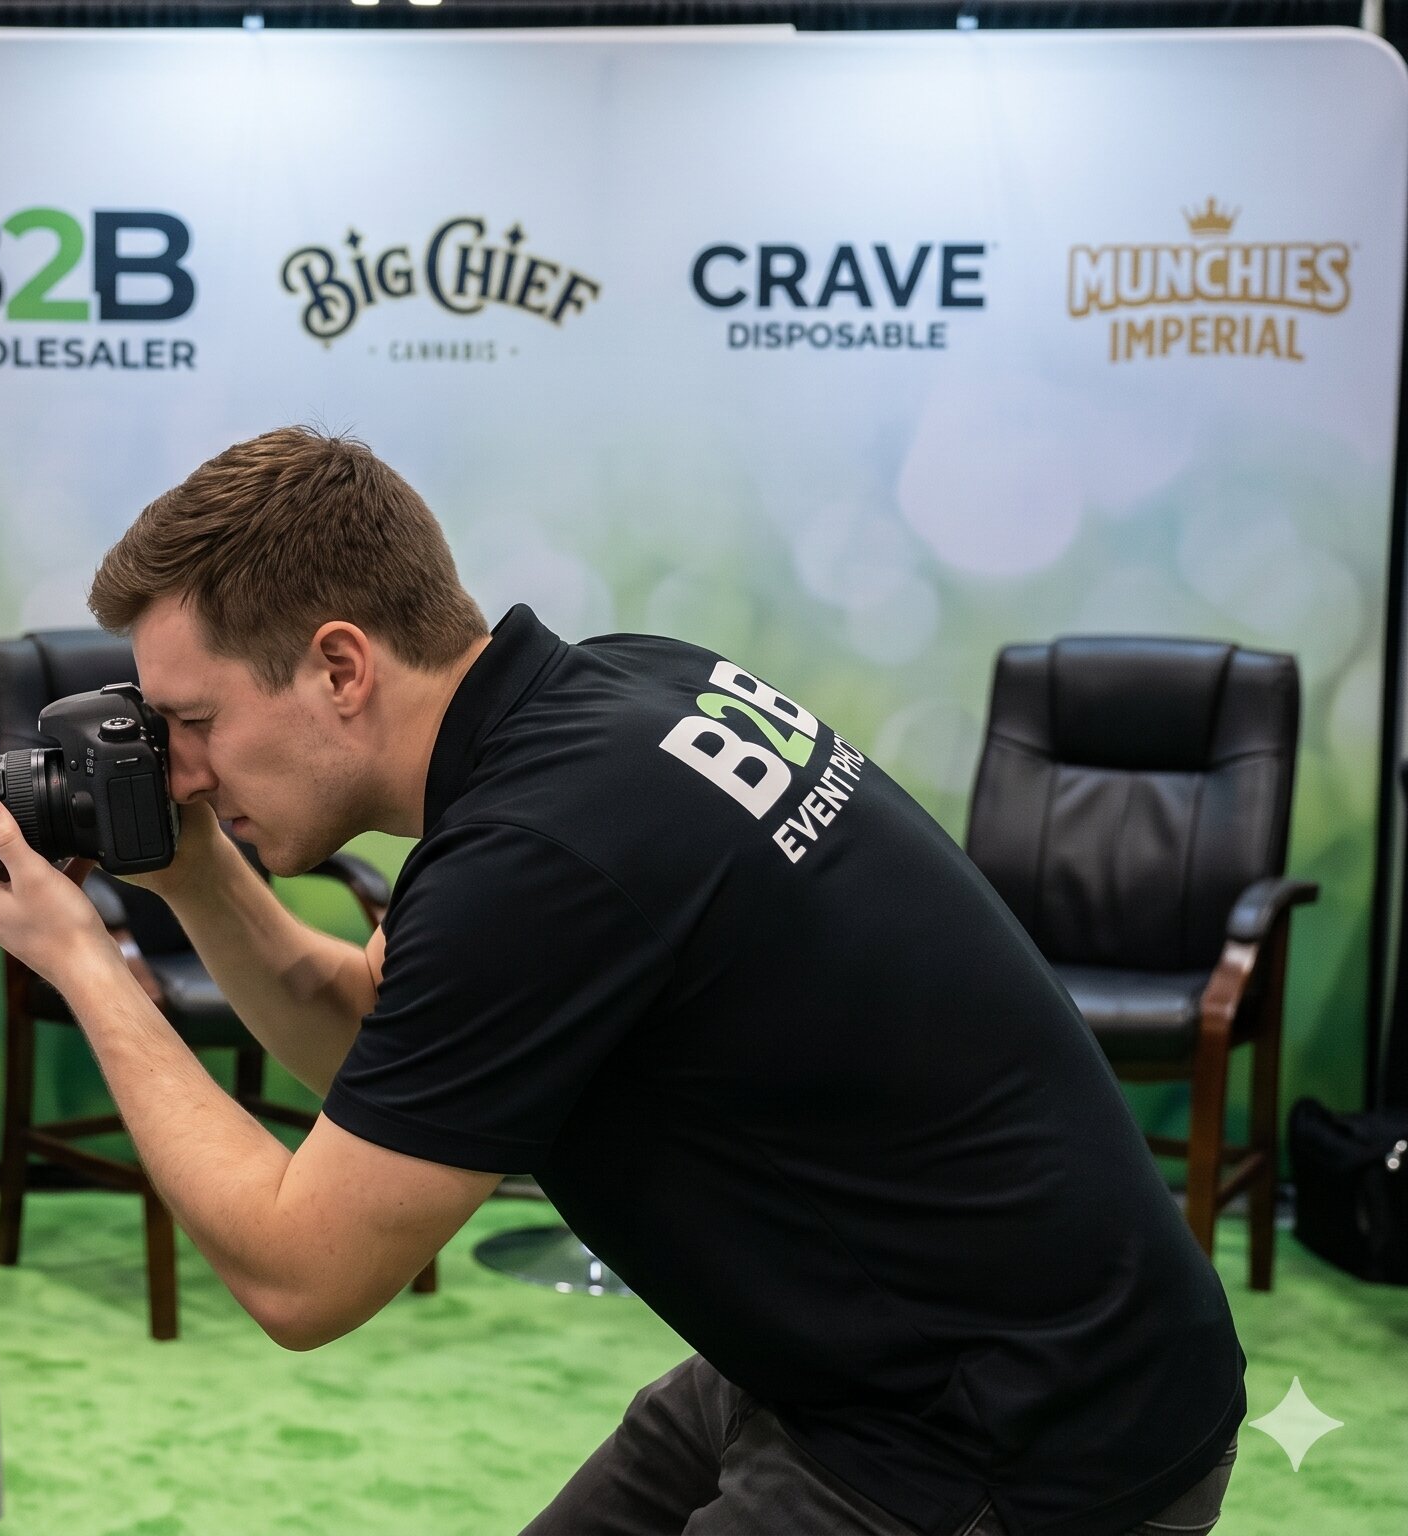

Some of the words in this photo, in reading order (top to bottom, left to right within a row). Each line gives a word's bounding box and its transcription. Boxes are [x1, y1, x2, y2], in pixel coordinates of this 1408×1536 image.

[692, 242, 986, 309] CRAVE
[1068, 242, 1351, 318] MUNCHIES
[389, 340, 497, 363] CANNABIS
[728, 322, 948, 349] DISPOSABLE
[1109, 314, 1306, 364] IMPERIAL
[659, 660, 819, 820] B2B
[772, 766, 854, 864] EVENT
[829, 731, 865, 781] PHO
